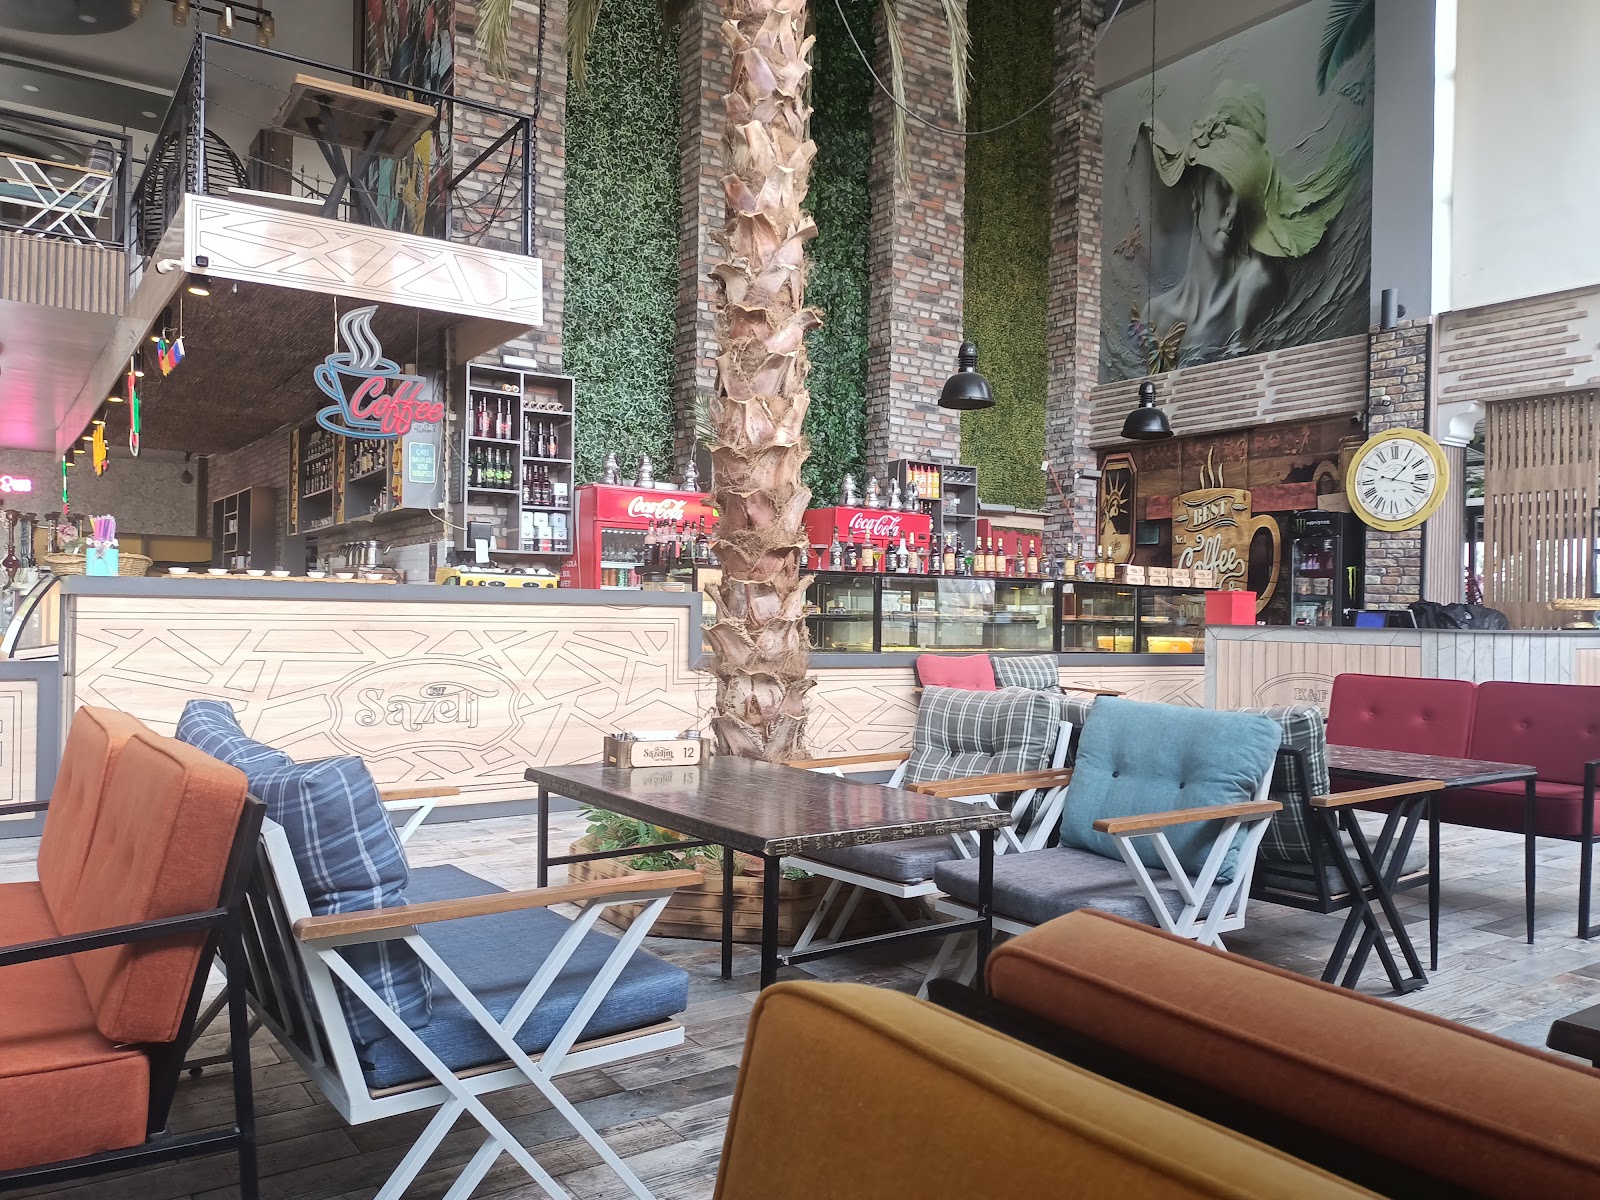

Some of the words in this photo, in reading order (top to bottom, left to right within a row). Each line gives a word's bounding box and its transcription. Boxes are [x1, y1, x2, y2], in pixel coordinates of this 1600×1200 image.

[351, 376, 444, 435] Coffee
[849, 512, 903, 537] Coca-Cola
[1192, 499, 1228, 527] BEST
[1293, 687, 1329, 703] K&F
[683, 747, 695, 758] 12
